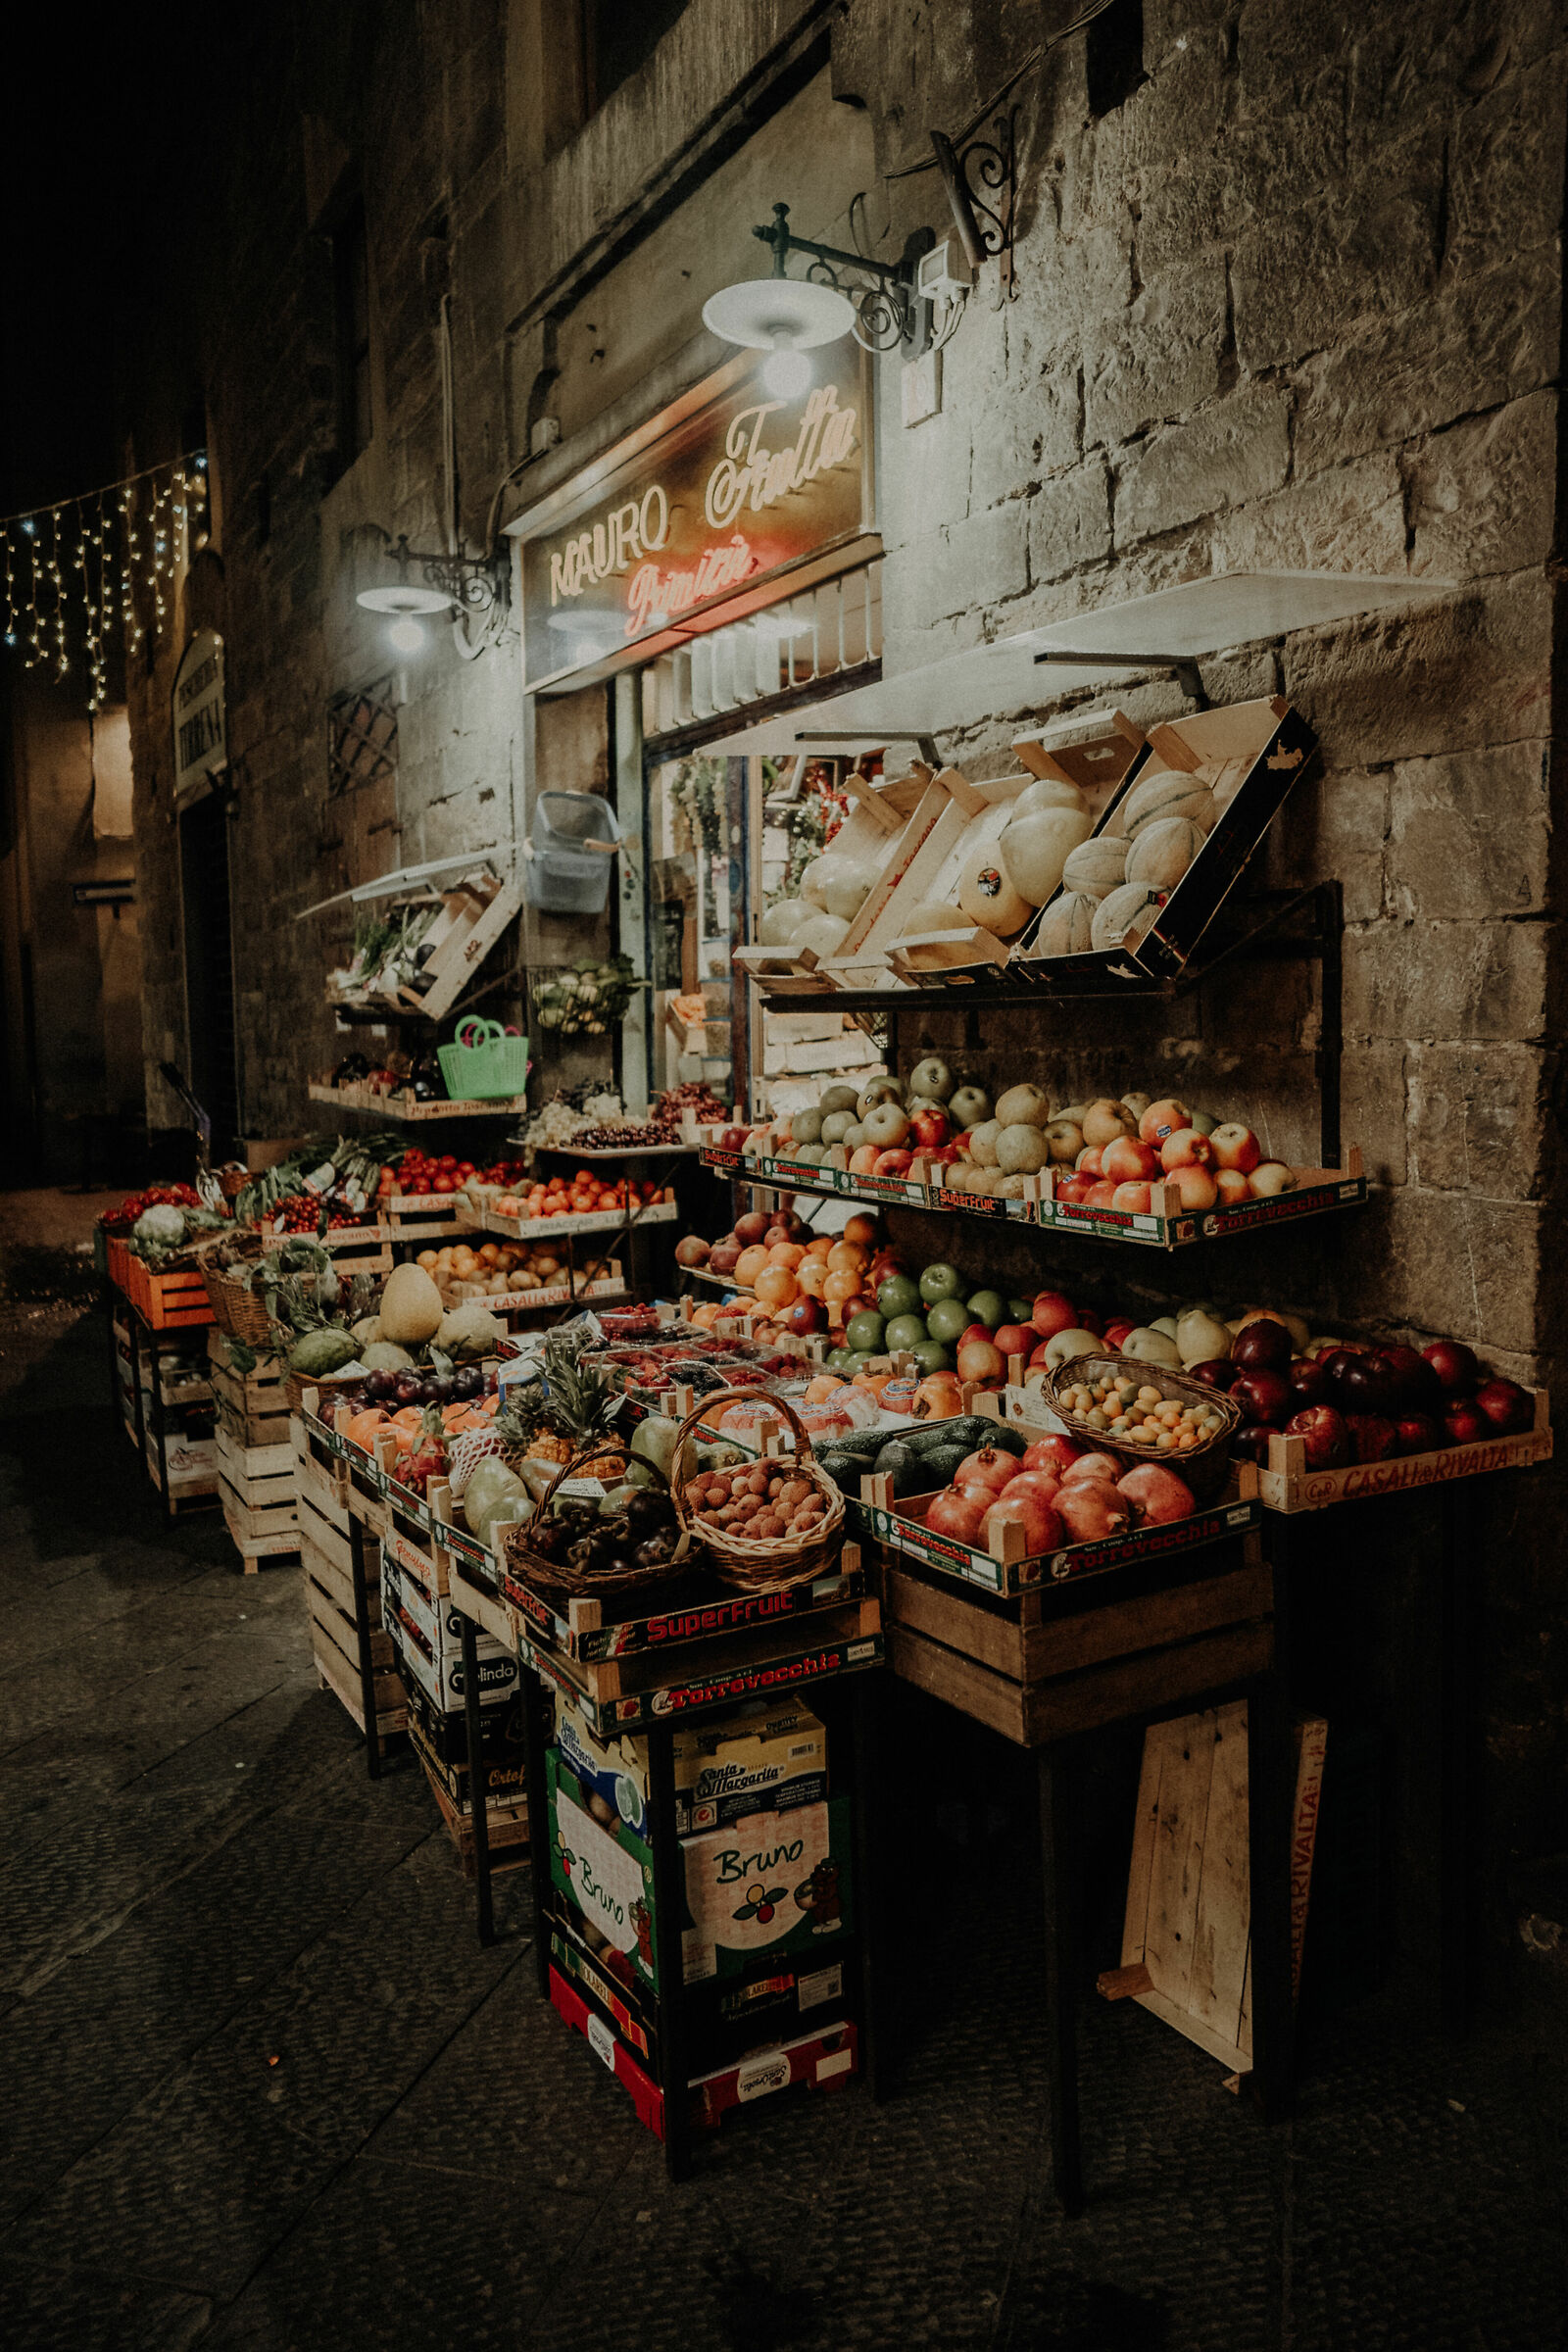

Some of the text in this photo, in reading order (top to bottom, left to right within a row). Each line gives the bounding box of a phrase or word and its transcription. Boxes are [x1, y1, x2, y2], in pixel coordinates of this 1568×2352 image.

[551, 485, 668, 607] MAURO
[700, 1764, 746, 1783] Santa
[708, 1766, 780, 1797] Margarita
[712, 1838, 804, 1885] Bruno
[579, 1856, 623, 1925] Bruno
